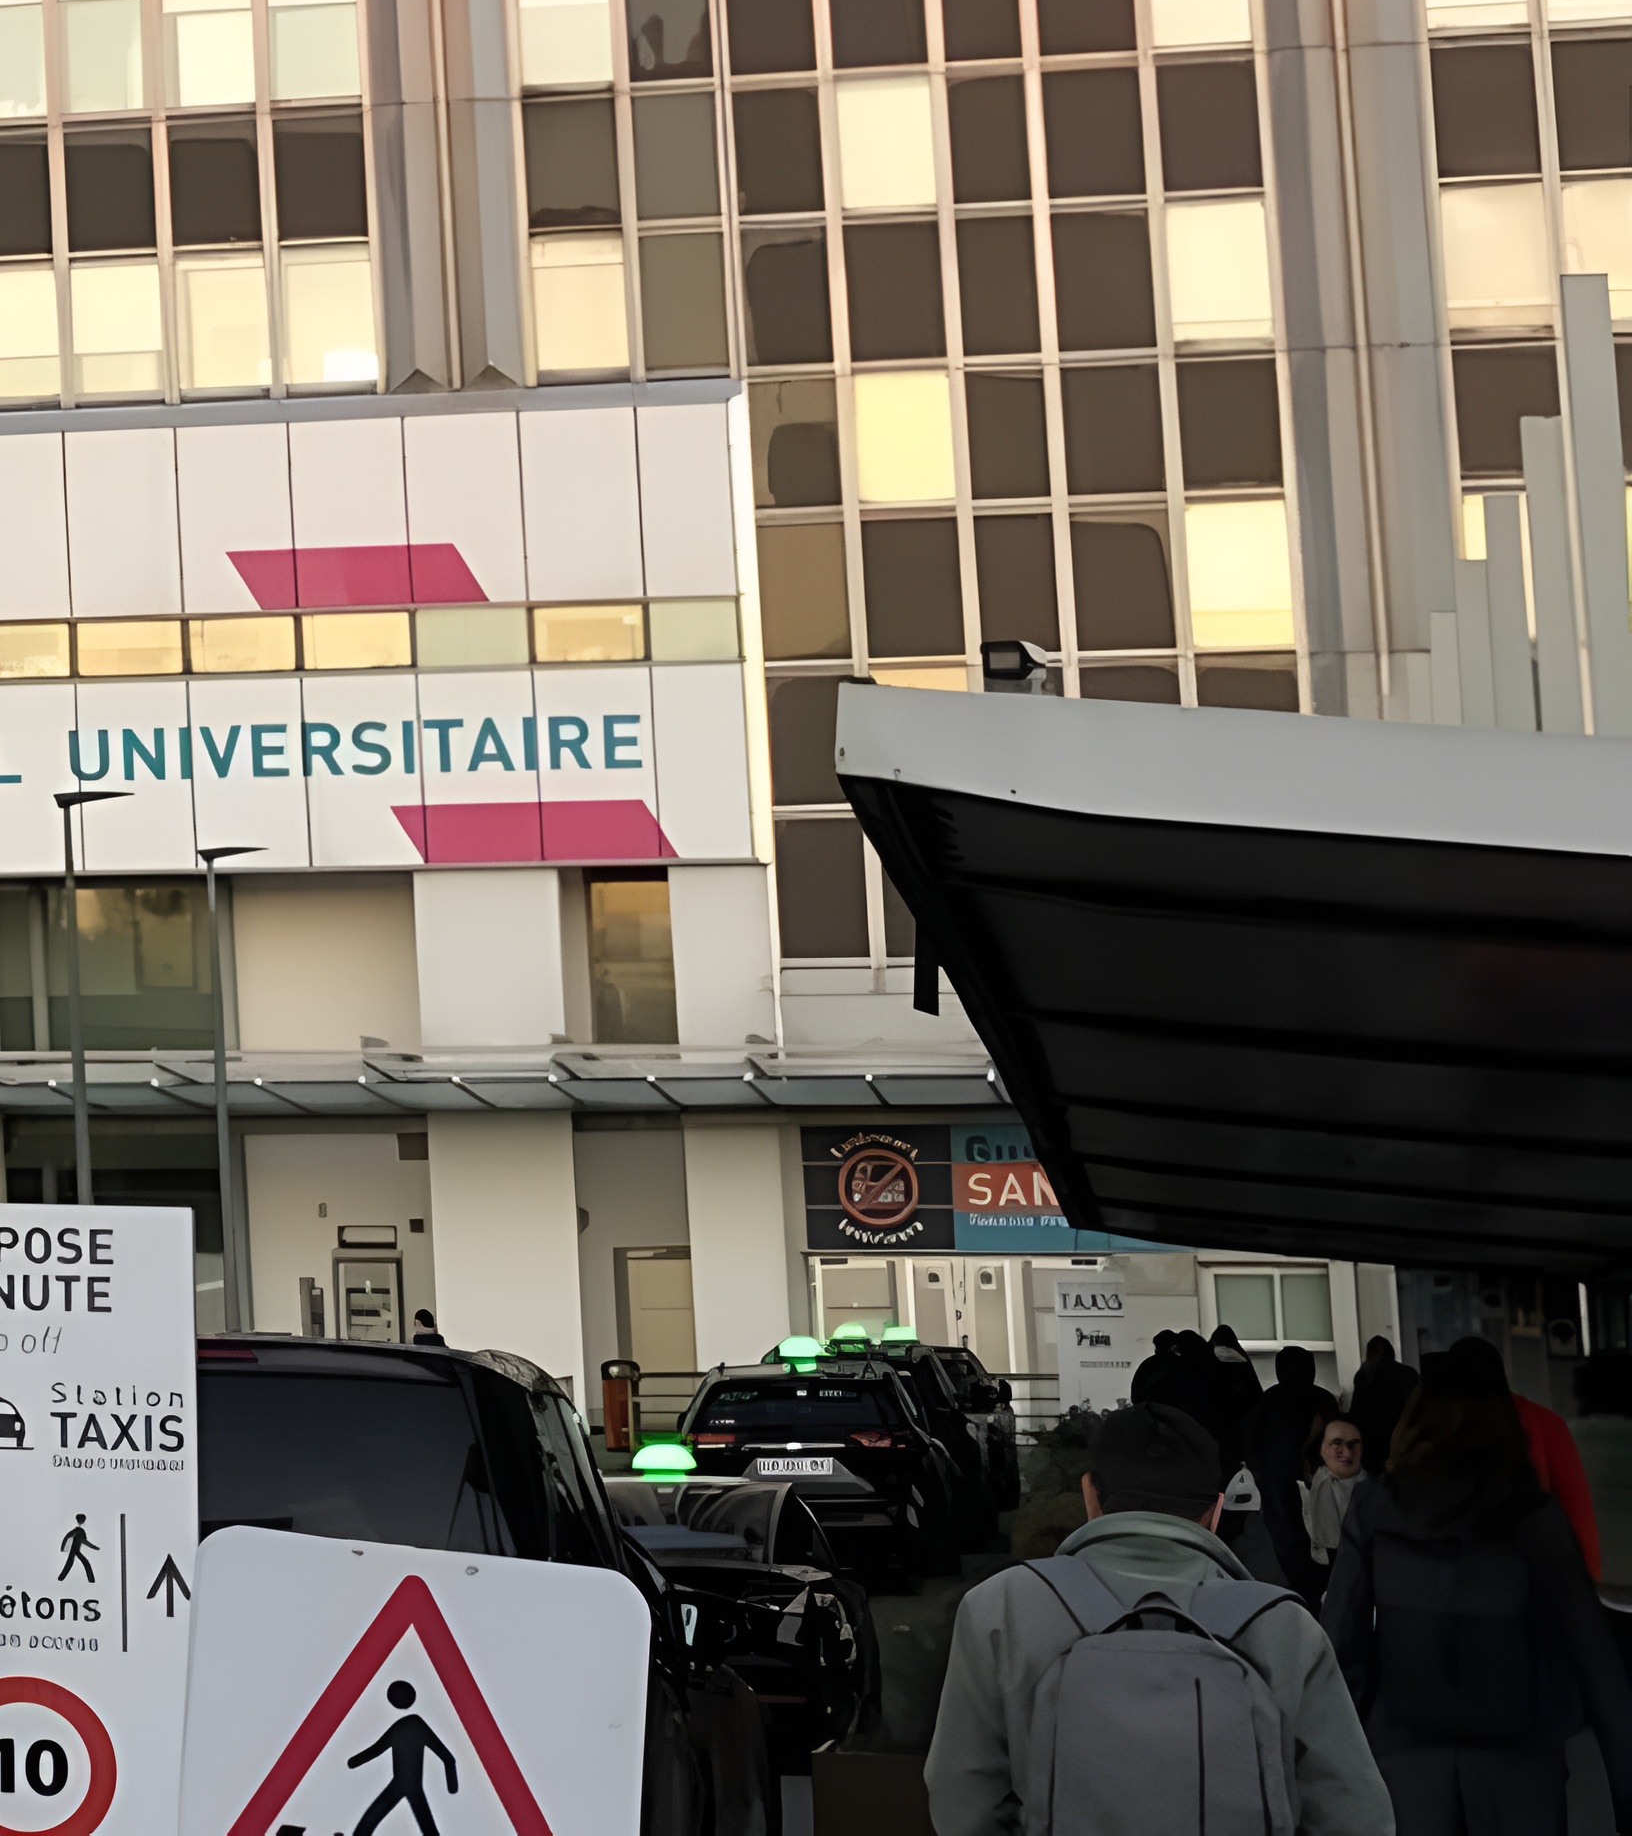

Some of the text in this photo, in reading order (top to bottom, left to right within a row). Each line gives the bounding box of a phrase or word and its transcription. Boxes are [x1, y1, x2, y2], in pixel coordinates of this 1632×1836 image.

[69, 713, 644, 783] UNIVERSITAIRE
[51, 1381, 184, 1409] Station
[50, 1411, 185, 1453] TAXIS
